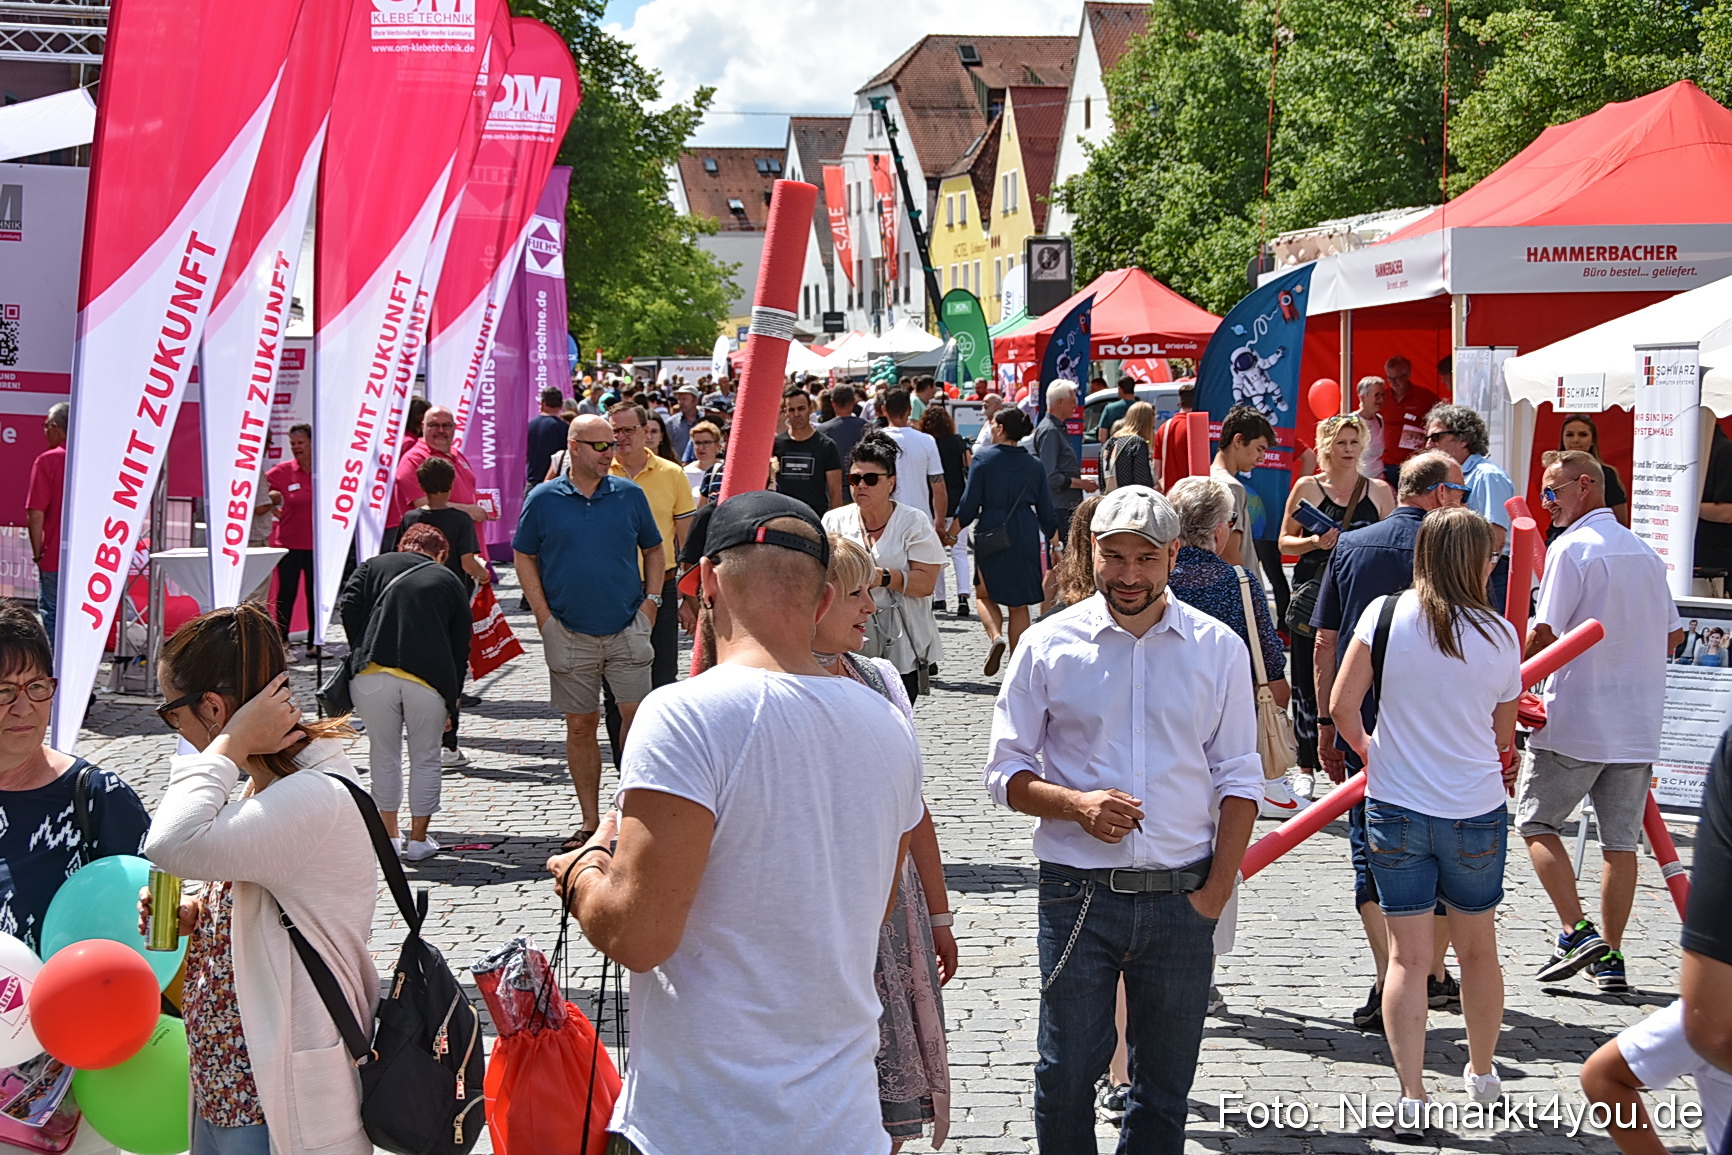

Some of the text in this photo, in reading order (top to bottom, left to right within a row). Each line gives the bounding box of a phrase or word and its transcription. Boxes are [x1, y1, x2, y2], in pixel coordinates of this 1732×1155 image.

[373, 12, 473, 23] KLEBE TECHNIK
[371, 43, 475, 53] www.om-klebetechnik.de
[827, 206, 852, 251] SALE
[528, 238, 561, 254] FUCHS
[1526, 245, 1678, 262] HAMMERBACHER
[1583, 266, 1698, 278] Büro bestel... geliefert.
[247, 250, 291, 406] ZUKUNFT
[463, 299, 498, 392] ZUKUNFT
[1099, 335, 1197, 355] RÖDL energie
[1656, 365, 1696, 376] SCHWARZ
[331, 270, 412, 530] JOBS MIT ZUKUNFT
[369, 285, 429, 512] JOBS MIT ZUKUNFT
[1566, 387, 1600, 398] SCHWARZ
[456, 396, 471, 433] MIT
[1645, 413, 1660, 422] SIND
[1661, 413, 1673, 422] IHR
[81, 230, 217, 631] JOBS MIT ZUKUNFT
[234, 410, 264, 471] MIT
[222, 479, 250, 567] JOBS
